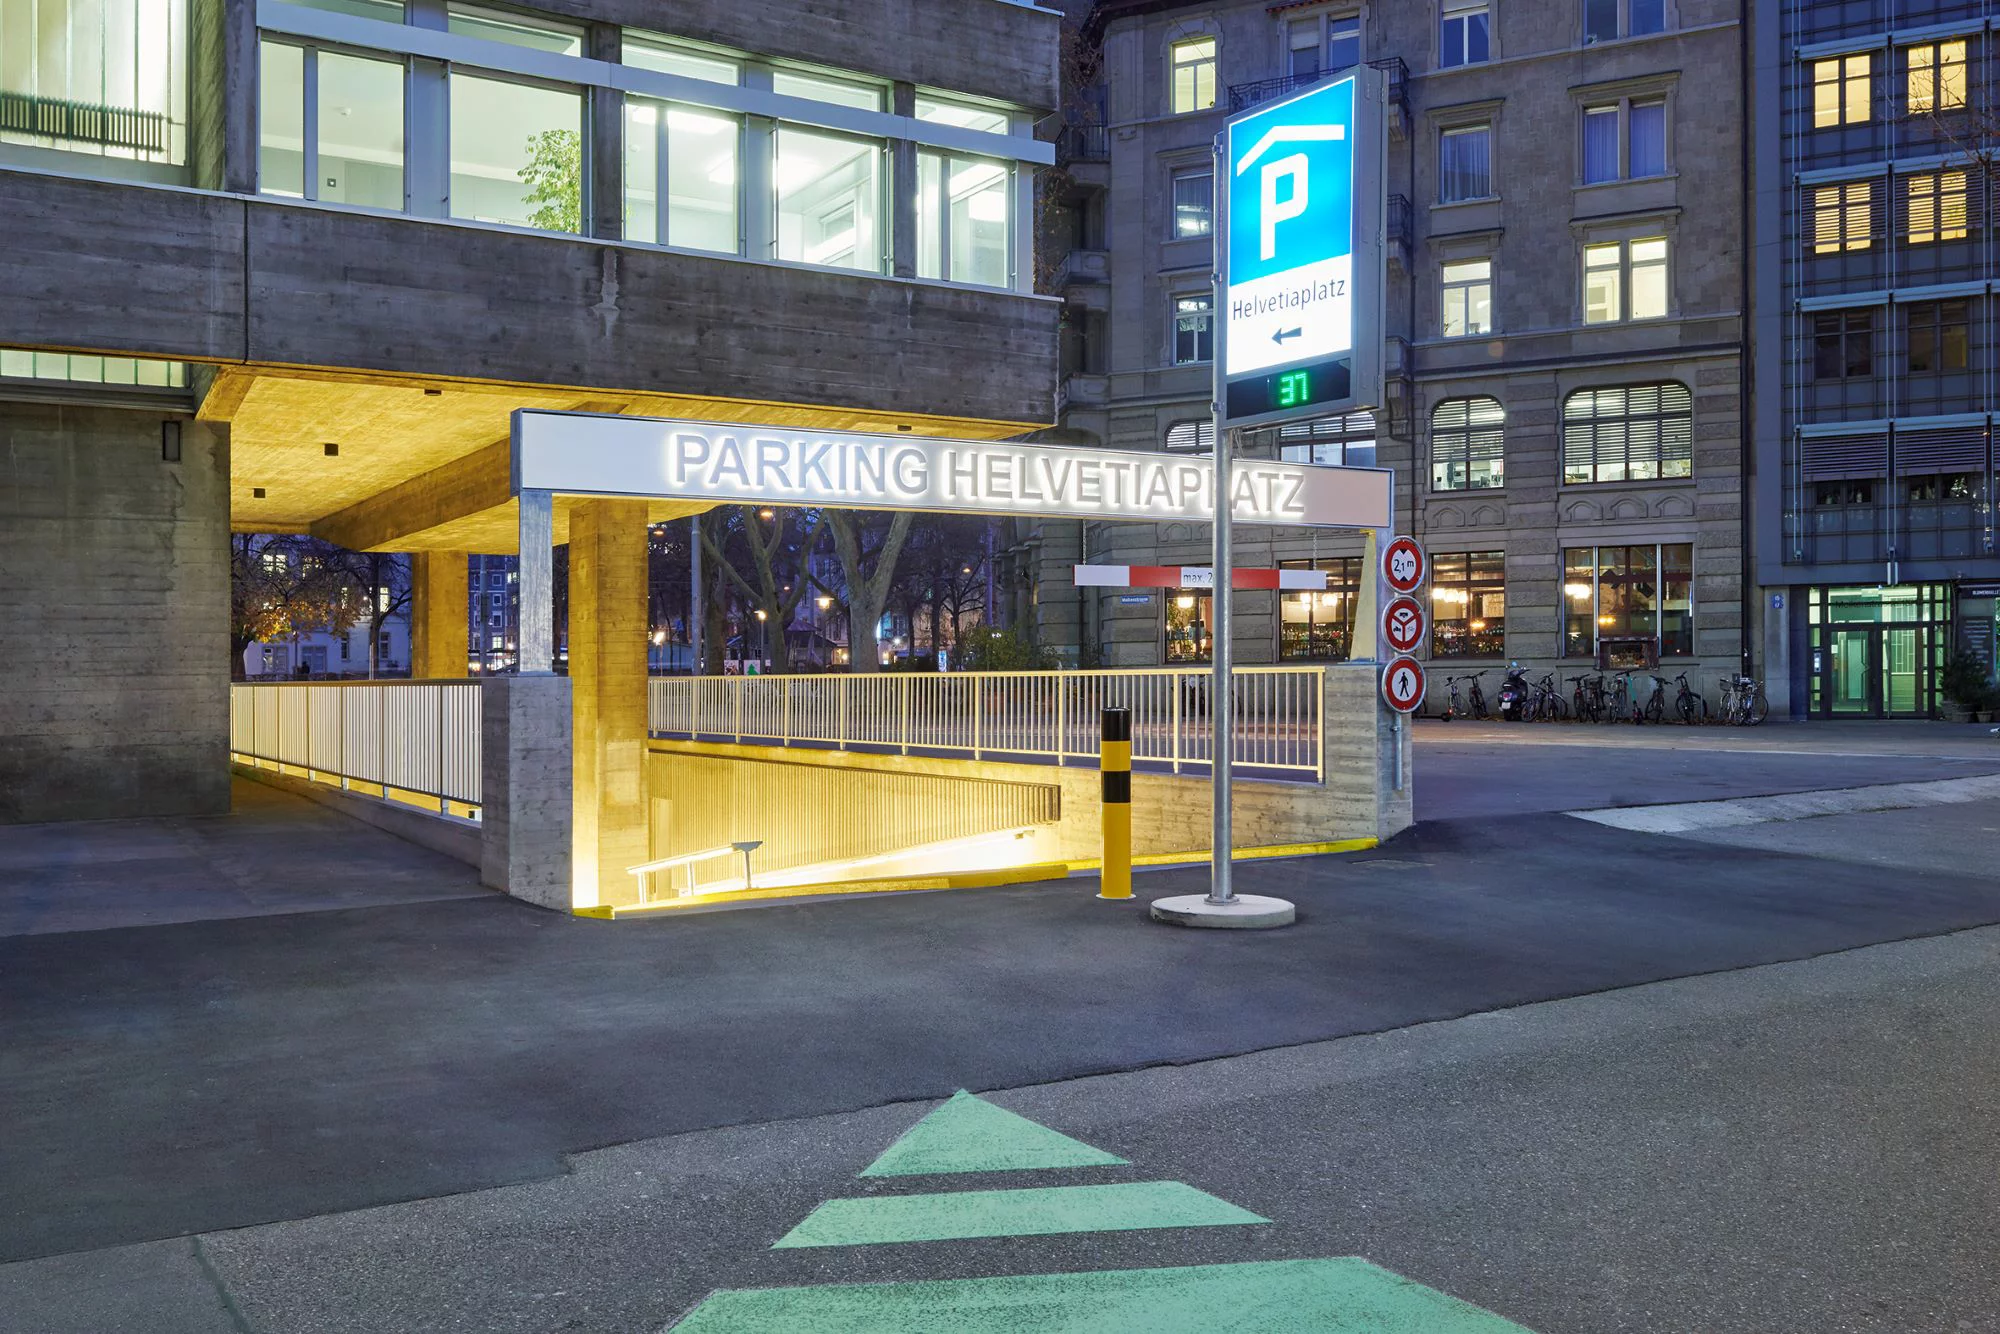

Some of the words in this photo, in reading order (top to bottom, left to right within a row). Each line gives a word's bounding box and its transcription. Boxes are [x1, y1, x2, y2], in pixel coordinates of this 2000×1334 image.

[1260, 152, 1309, 261] P
[1233, 277, 1345, 321] Helvetiaplatz
[1280, 372, 1309, 405] 37
[675, 432, 928, 494] PARKING
